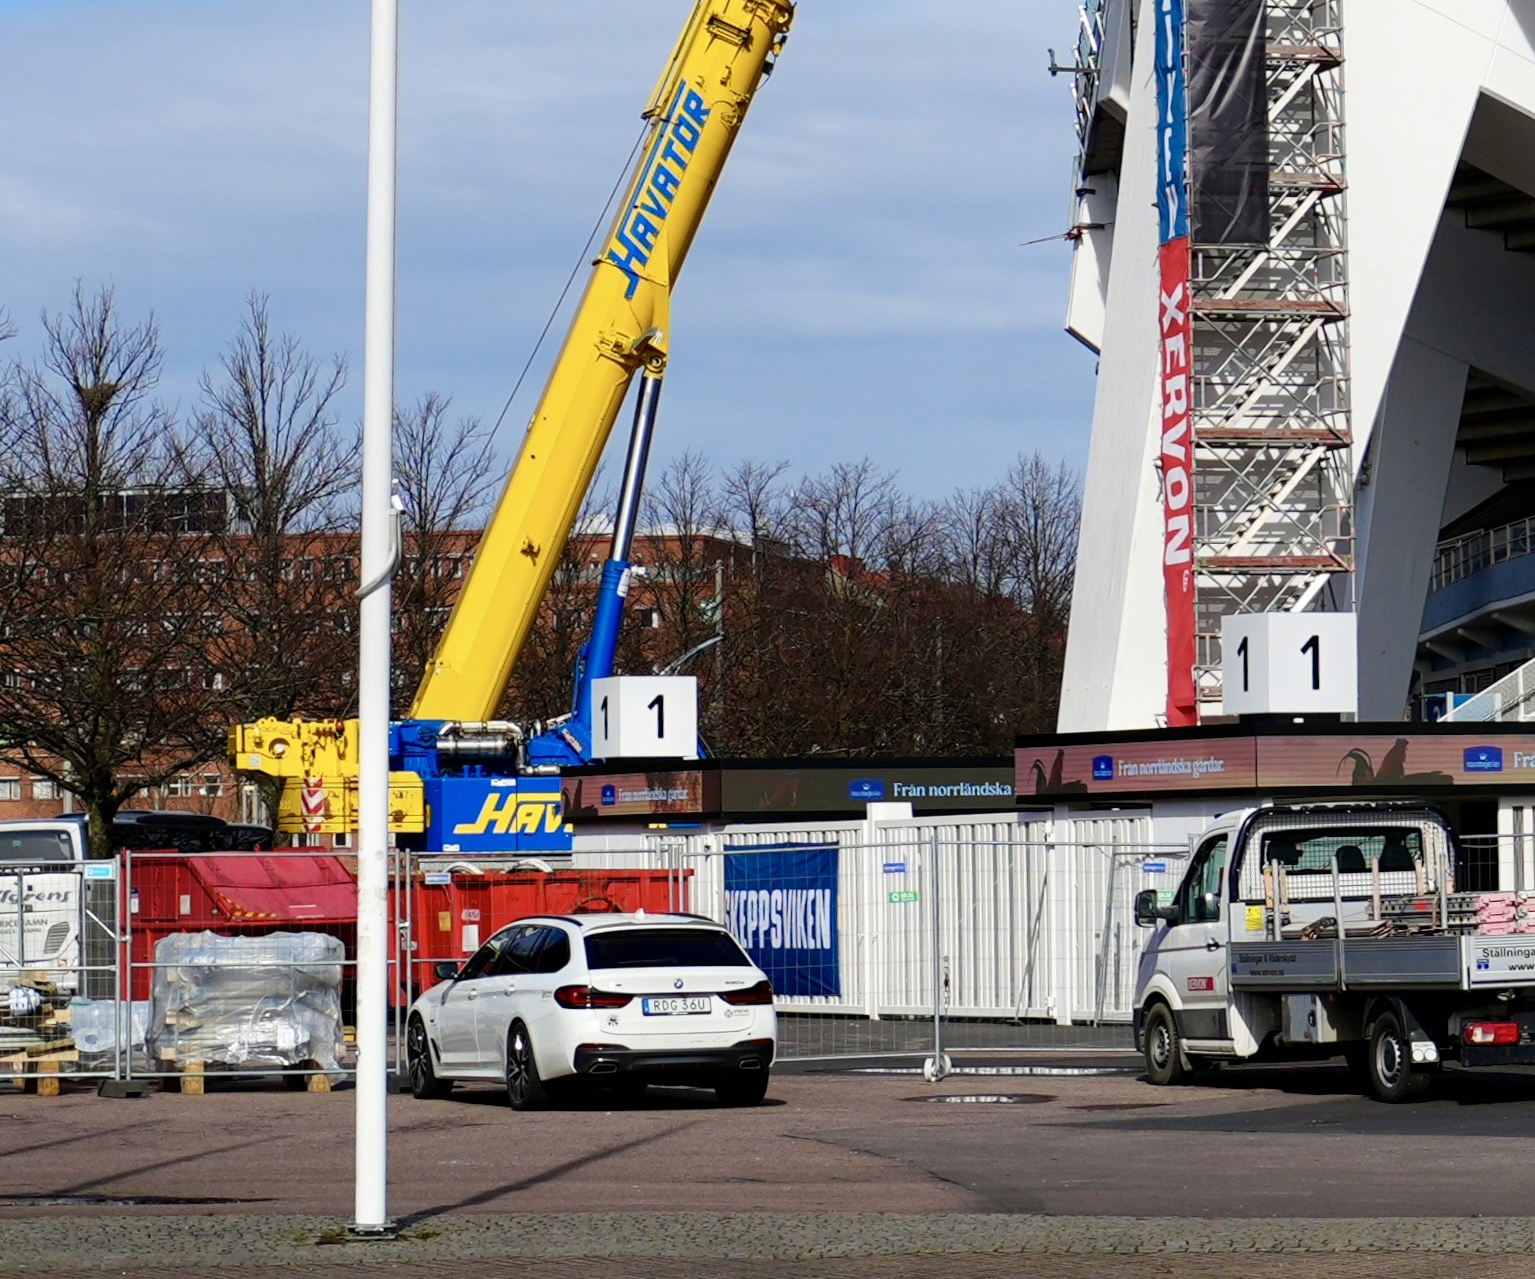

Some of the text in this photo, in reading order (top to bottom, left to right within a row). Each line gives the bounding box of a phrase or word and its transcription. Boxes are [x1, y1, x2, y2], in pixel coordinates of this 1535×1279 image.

[607, 79, 711, 300] HAVATOR
[1161, 281, 1191, 565] XERVON
[1237, 636, 1249, 692] 1
[1300, 635, 1320, 690] 1
[600, 695, 609, 740] 1
[647, 694, 665, 739] 1
[893, 782, 926, 797] Från
[928, 782, 1012, 797] norrländska
[453, 793, 574, 834] HAV
[653, 999, 705, 1011] RDG 36U
